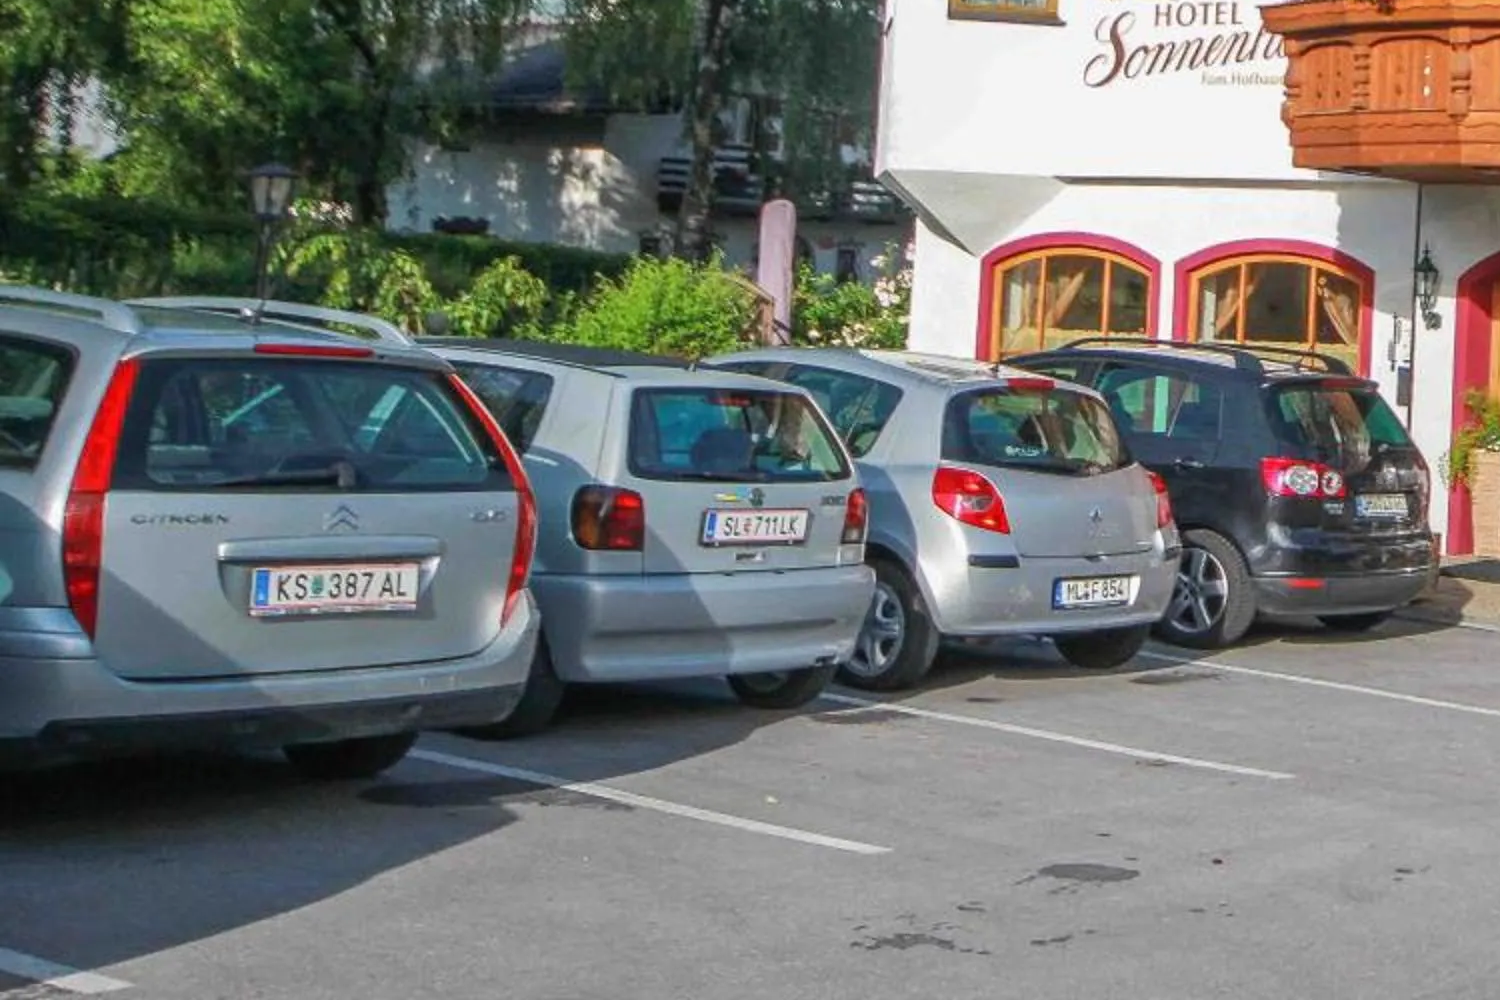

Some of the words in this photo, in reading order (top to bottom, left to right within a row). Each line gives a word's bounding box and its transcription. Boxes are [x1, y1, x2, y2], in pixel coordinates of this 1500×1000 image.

[1153, 1, 1243, 27] HOTEL
[724, 516, 741, 537] SL
[277, 574, 309, 601] KS
[329, 573, 374, 598] 387
[380, 572, 406, 597] AL
